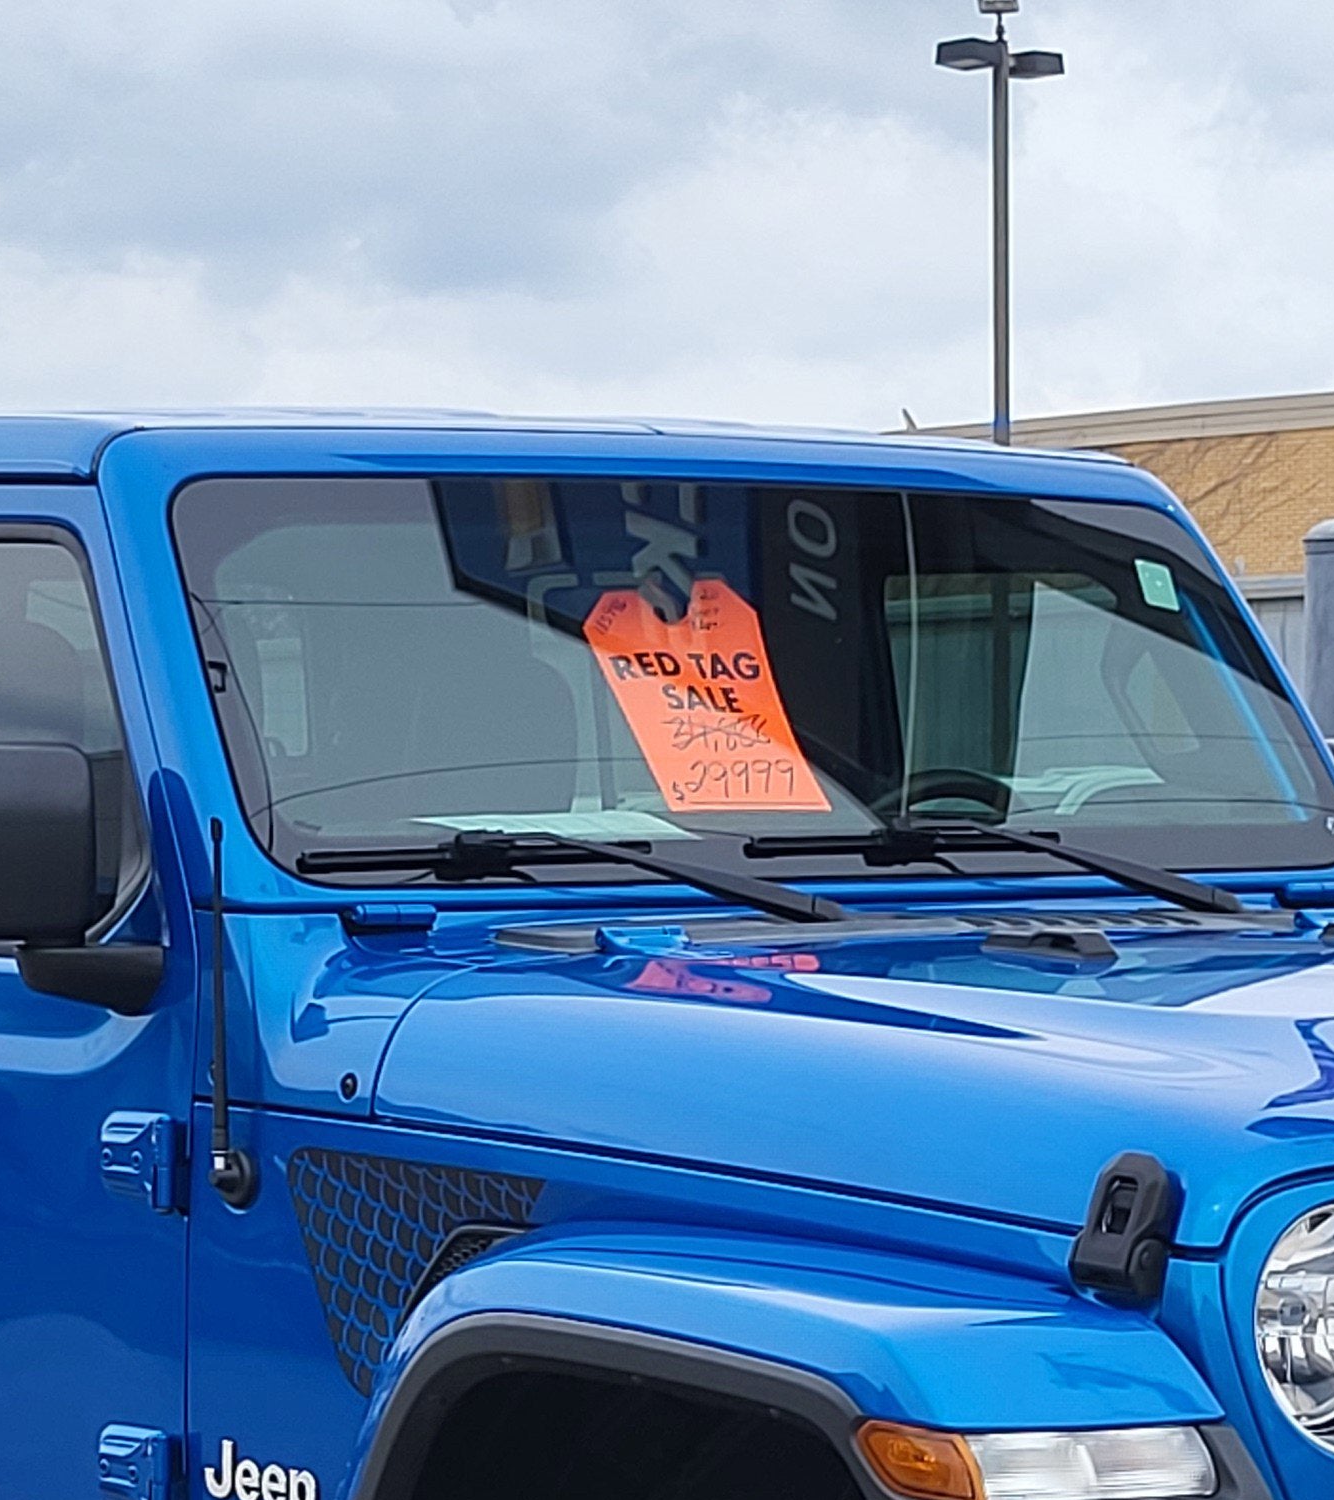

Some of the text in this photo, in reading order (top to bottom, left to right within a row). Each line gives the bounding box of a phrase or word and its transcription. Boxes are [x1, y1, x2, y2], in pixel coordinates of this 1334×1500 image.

[609, 652, 760, 680] RED TAG
[662, 683, 744, 713] SALE
